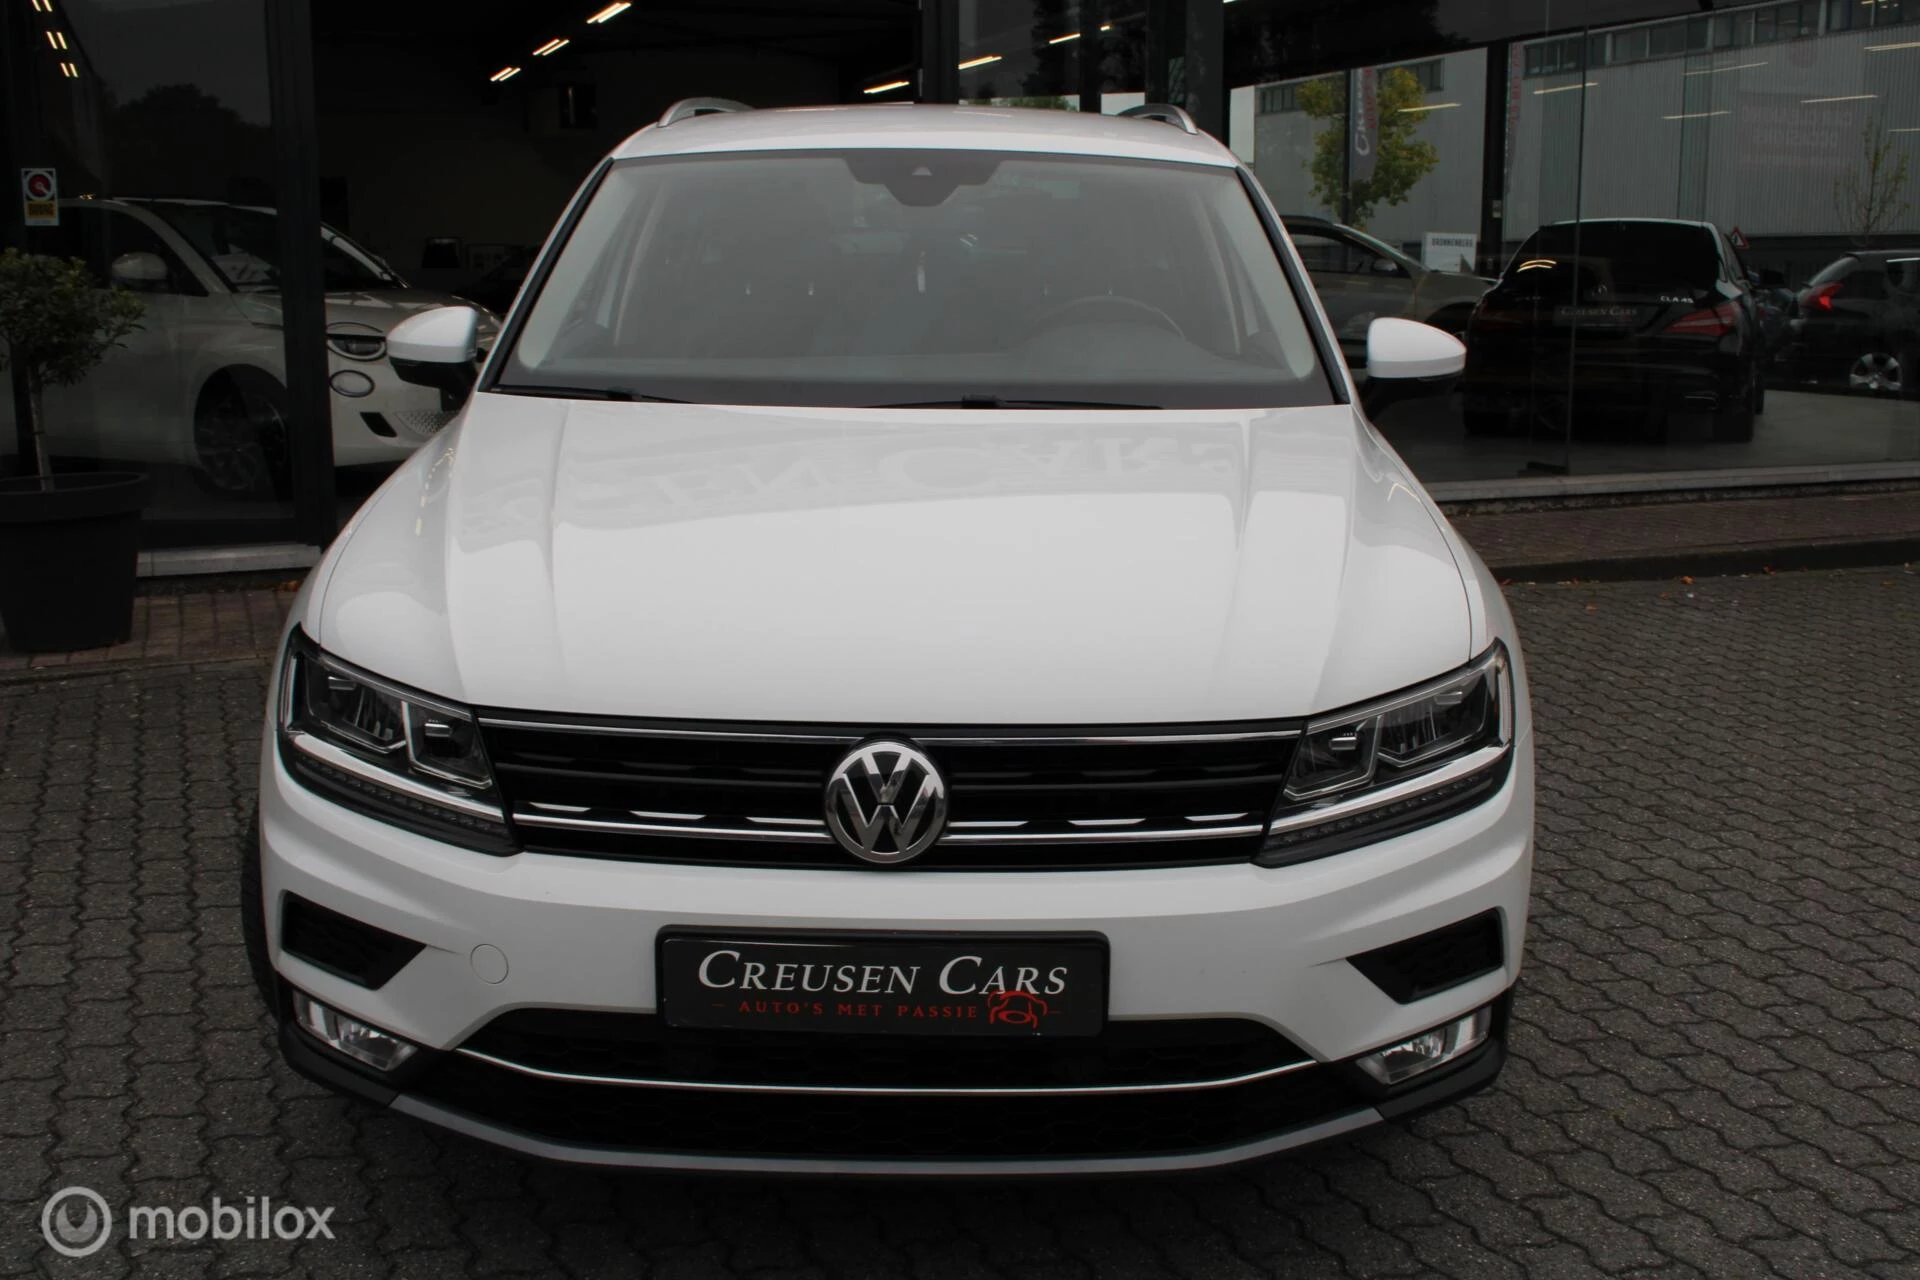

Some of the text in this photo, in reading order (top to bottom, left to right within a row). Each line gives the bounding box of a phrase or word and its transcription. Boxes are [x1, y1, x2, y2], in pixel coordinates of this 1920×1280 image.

[698, 949, 1068, 996] CREUSEN CARS
[739, 1001, 977, 1019] AUTO'S MET PASSIE
